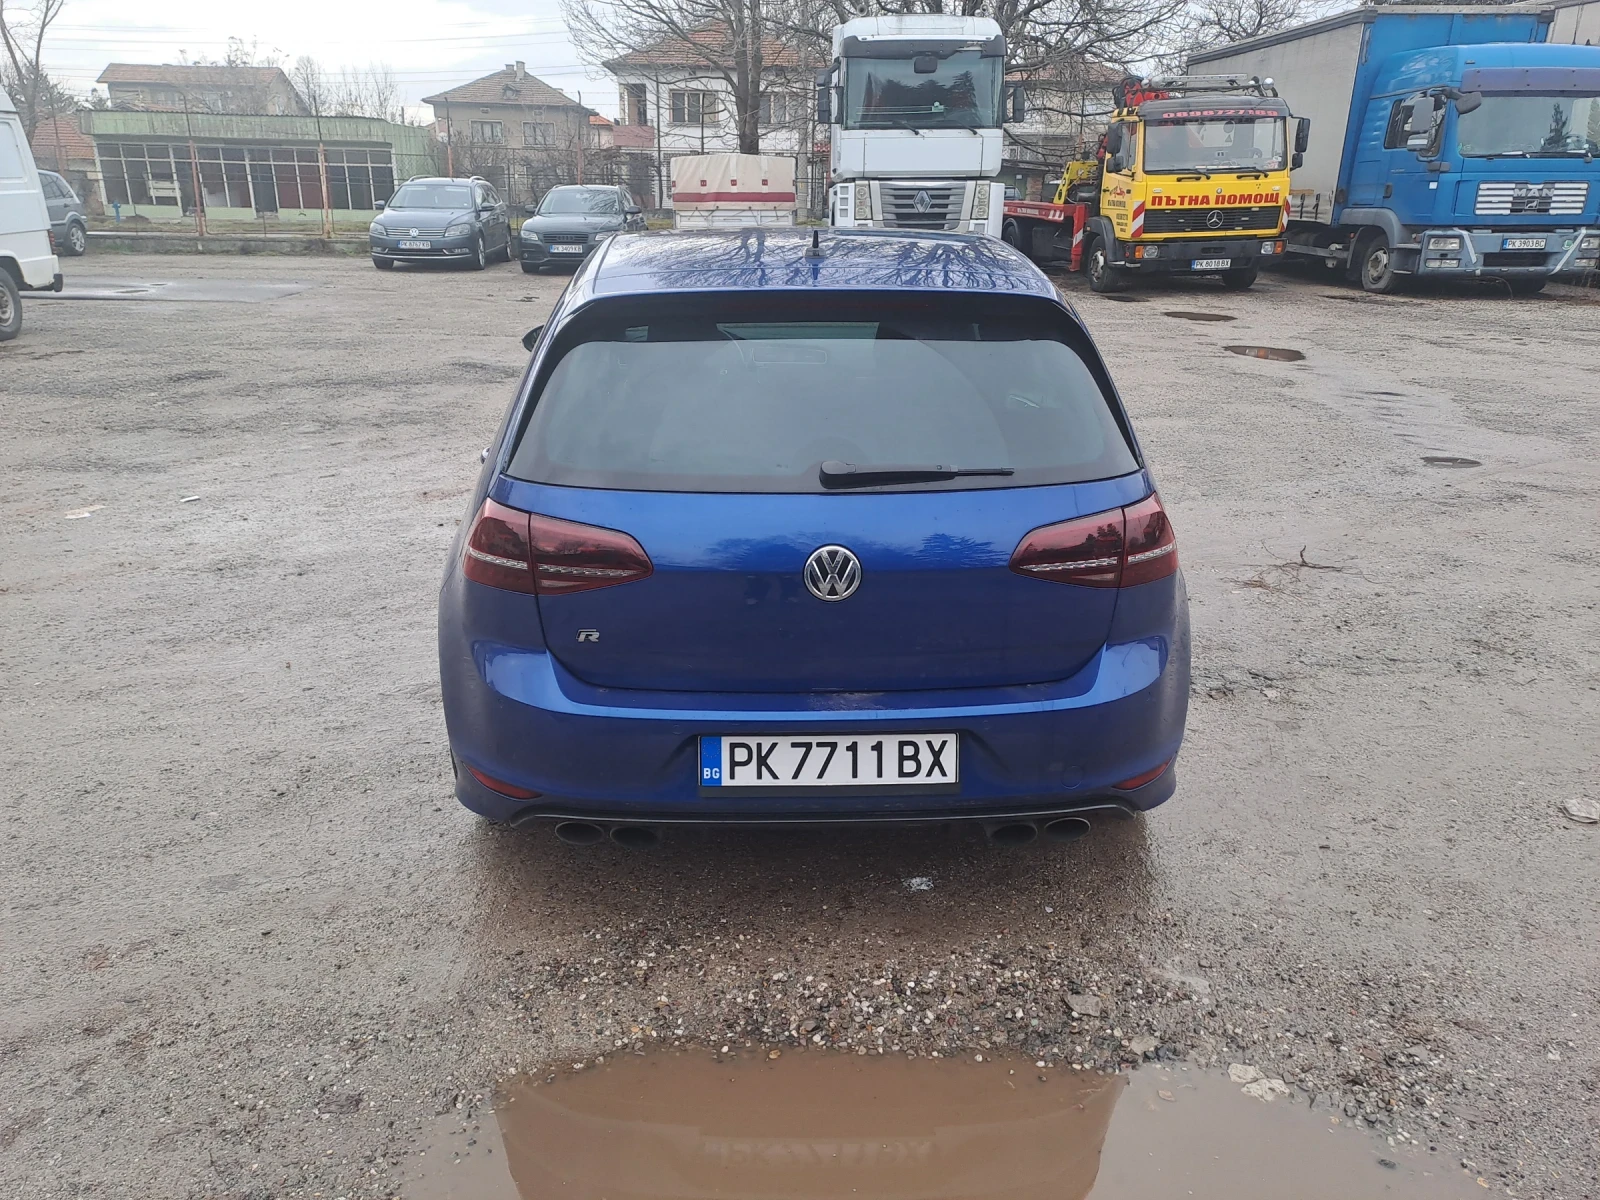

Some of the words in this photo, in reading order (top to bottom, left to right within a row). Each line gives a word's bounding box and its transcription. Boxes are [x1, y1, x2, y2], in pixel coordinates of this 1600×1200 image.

[1151, 195, 1211, 207] ПЪТНА
[1214, 192, 1280, 206] ПОМОЩ
[1513, 188, 1555, 198] MAN
[576, 629, 600, 643] R
[703, 767, 720, 779] BG
